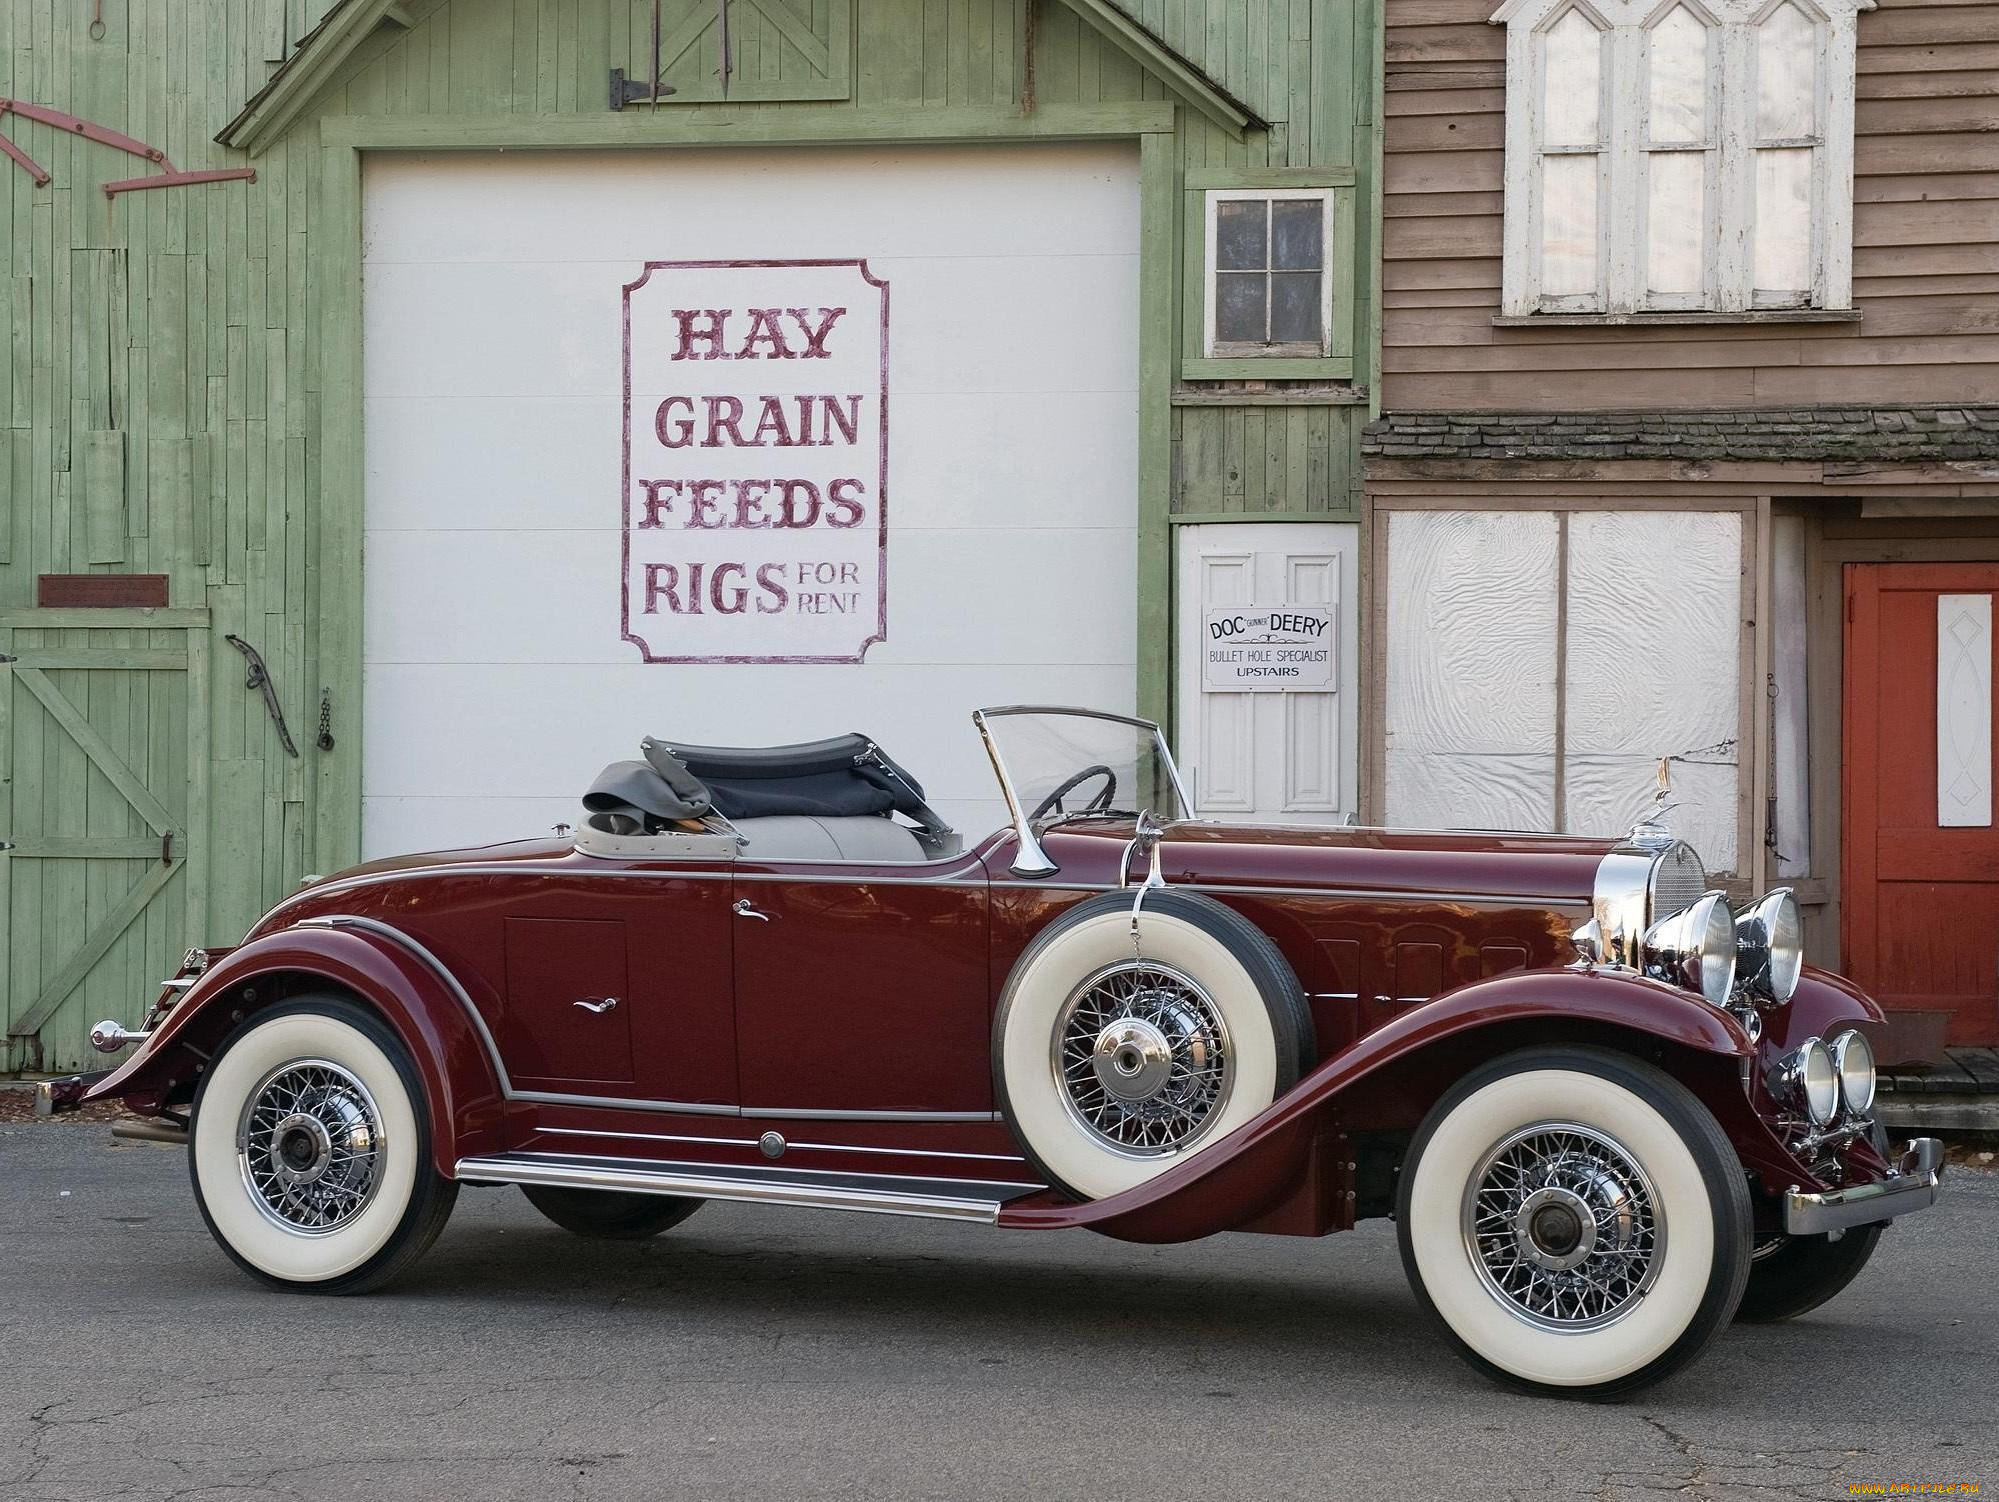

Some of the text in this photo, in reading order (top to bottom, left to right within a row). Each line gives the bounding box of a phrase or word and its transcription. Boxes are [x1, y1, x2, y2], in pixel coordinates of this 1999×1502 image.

[671, 308, 847, 361] HAY
[655, 395, 864, 448] GRAIN
[638, 479, 866, 529] FEEDS
[797, 562, 860, 584] FOR
[641, 562, 789, 614] RIGS
[798, 592, 860, 614] RENT
[1210, 616, 1245, 639] DOC
[1270, 613, 1329, 637] DEERY
[1209, 650, 1328, 662] BULLET HOLE SPECIALIST
[1237, 667, 1299, 677] UPSTAIRS
